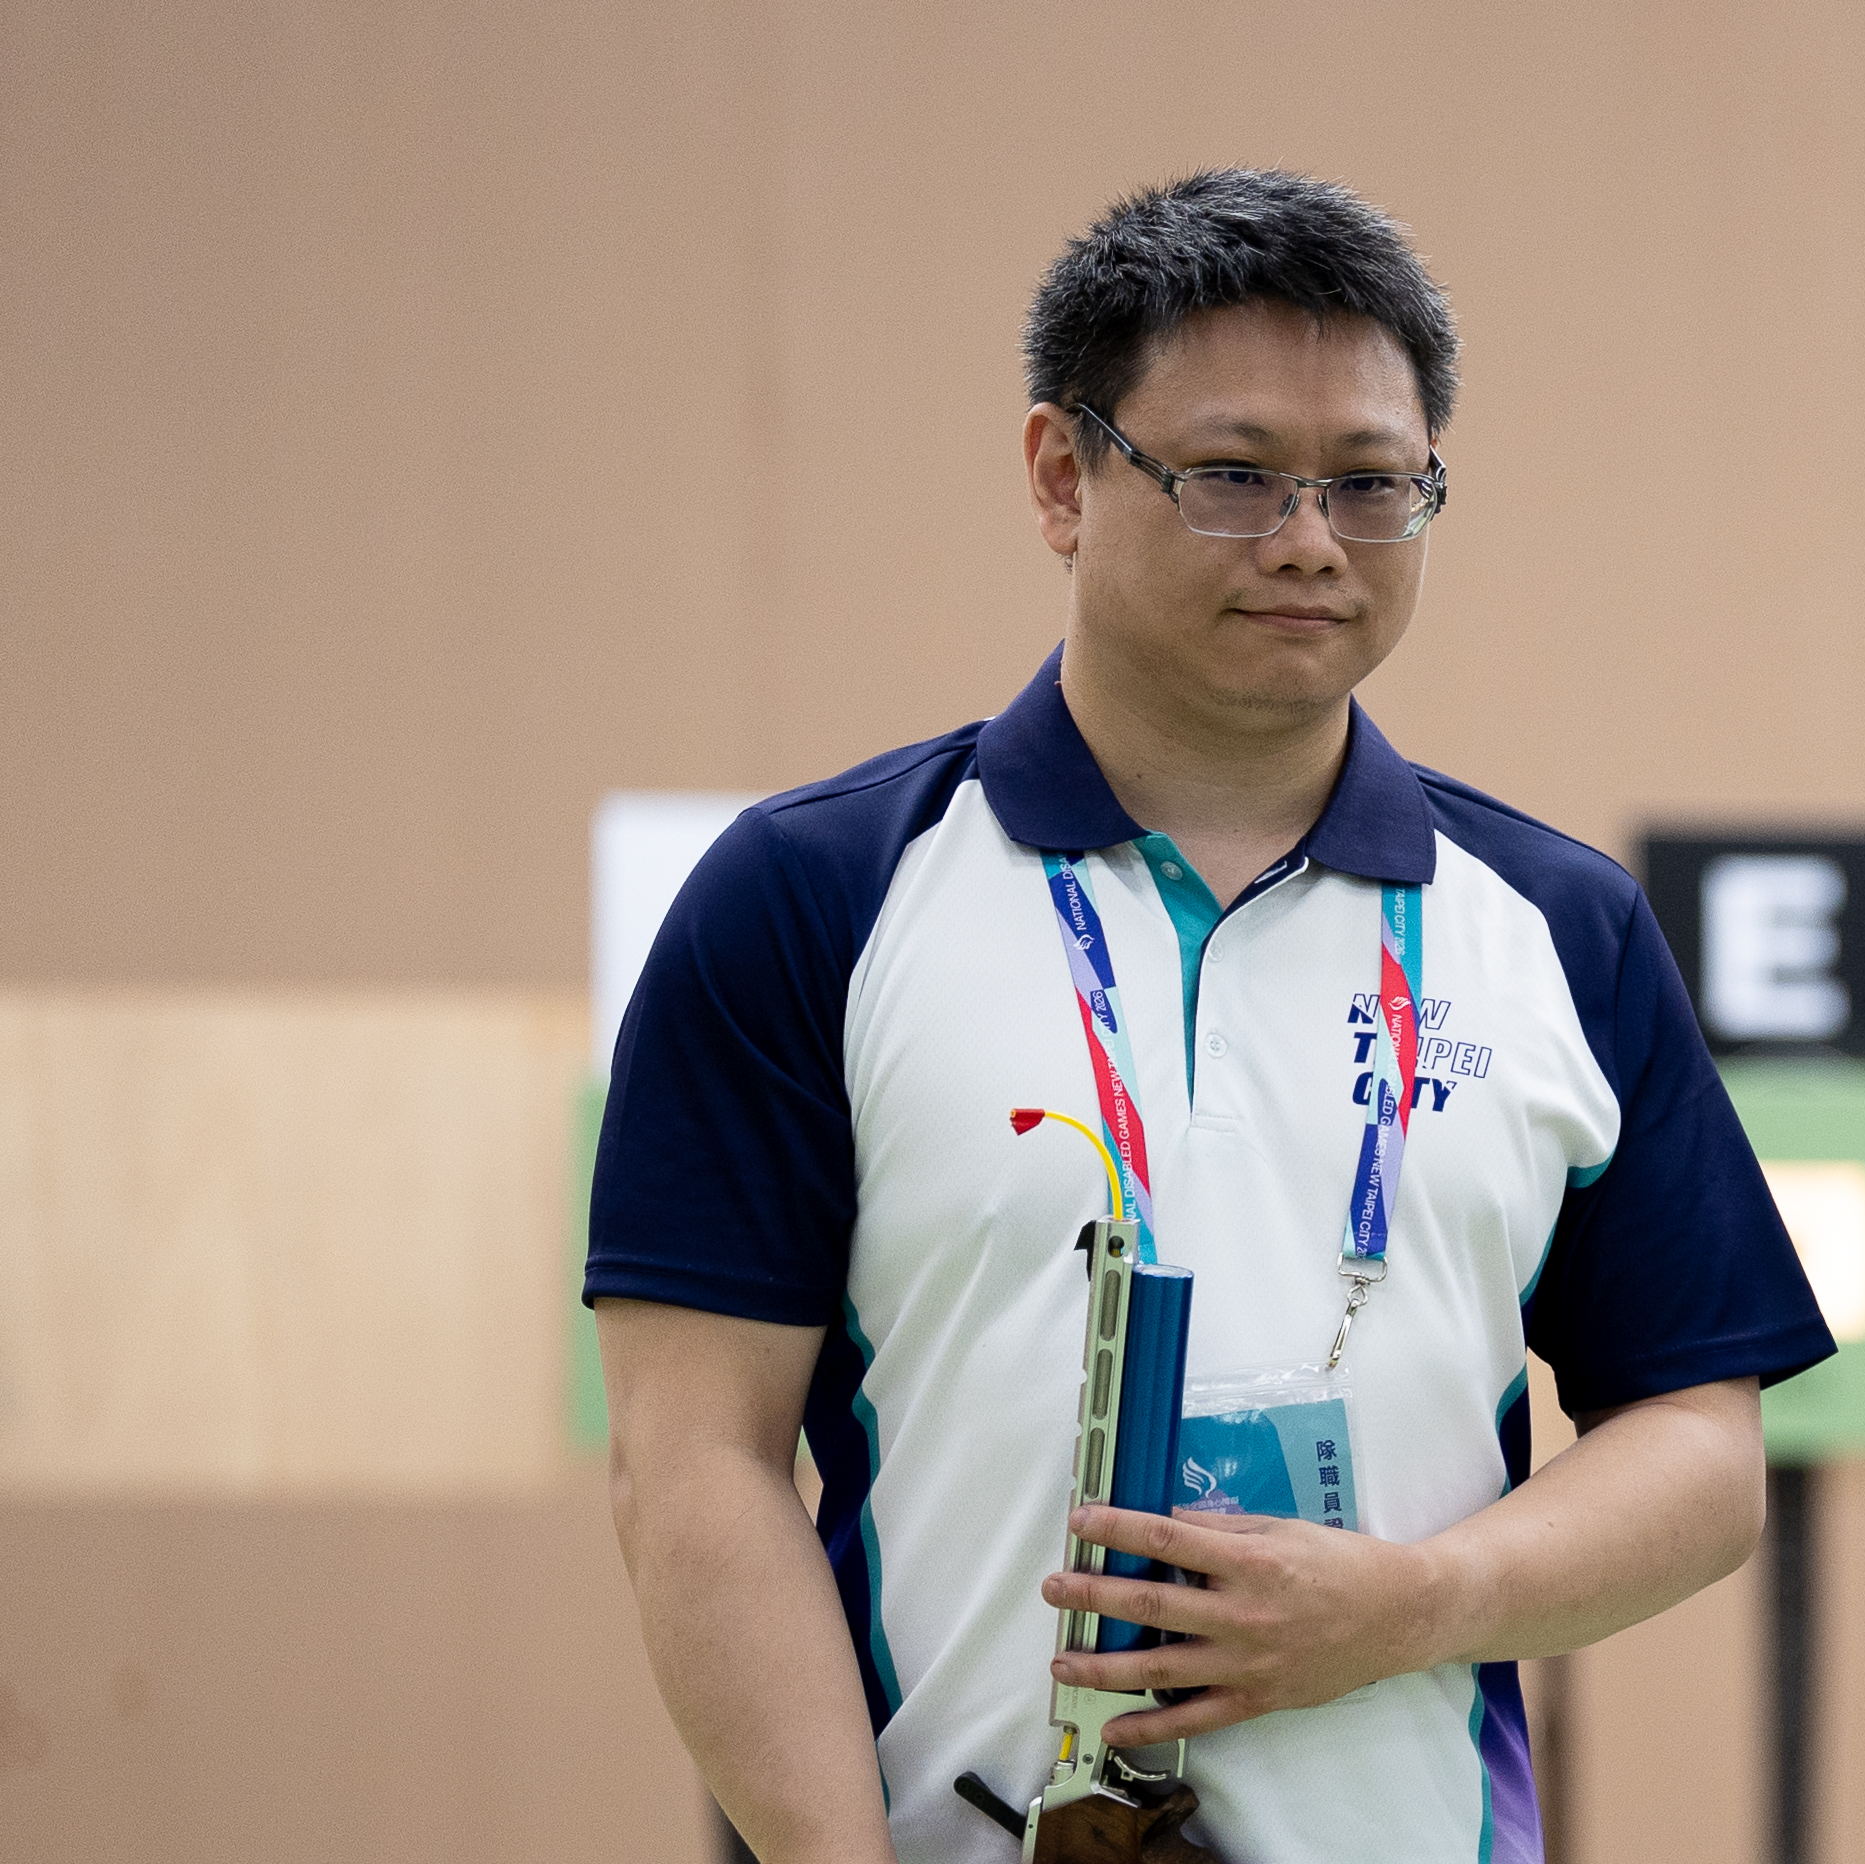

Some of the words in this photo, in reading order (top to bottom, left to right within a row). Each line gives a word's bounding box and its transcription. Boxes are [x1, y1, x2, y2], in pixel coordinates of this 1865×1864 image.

[1066, 881, 1087, 931] NATIONAL
[1394, 915, 1406, 936] CITY
[1702, 853, 1852, 1040] E
[1347, 993, 1451, 1031] NW
[1353, 1032, 1493, 1078] TIPEI
[1390, 1014, 1403, 1062] NATIONAL
[1110, 1070, 1124, 1097] NEW
[1352, 1072, 1458, 1112] CTY
[1114, 1099, 1130, 1141] GAMES
[1374, 1115, 1392, 1157] GAMES
[1120, 1142, 1136, 1198] DISABLED
[1369, 1157, 1385, 1187] NEW
[1361, 1187, 1379, 1220] TAIPEI
[1358, 1221, 1371, 1246] CITY
